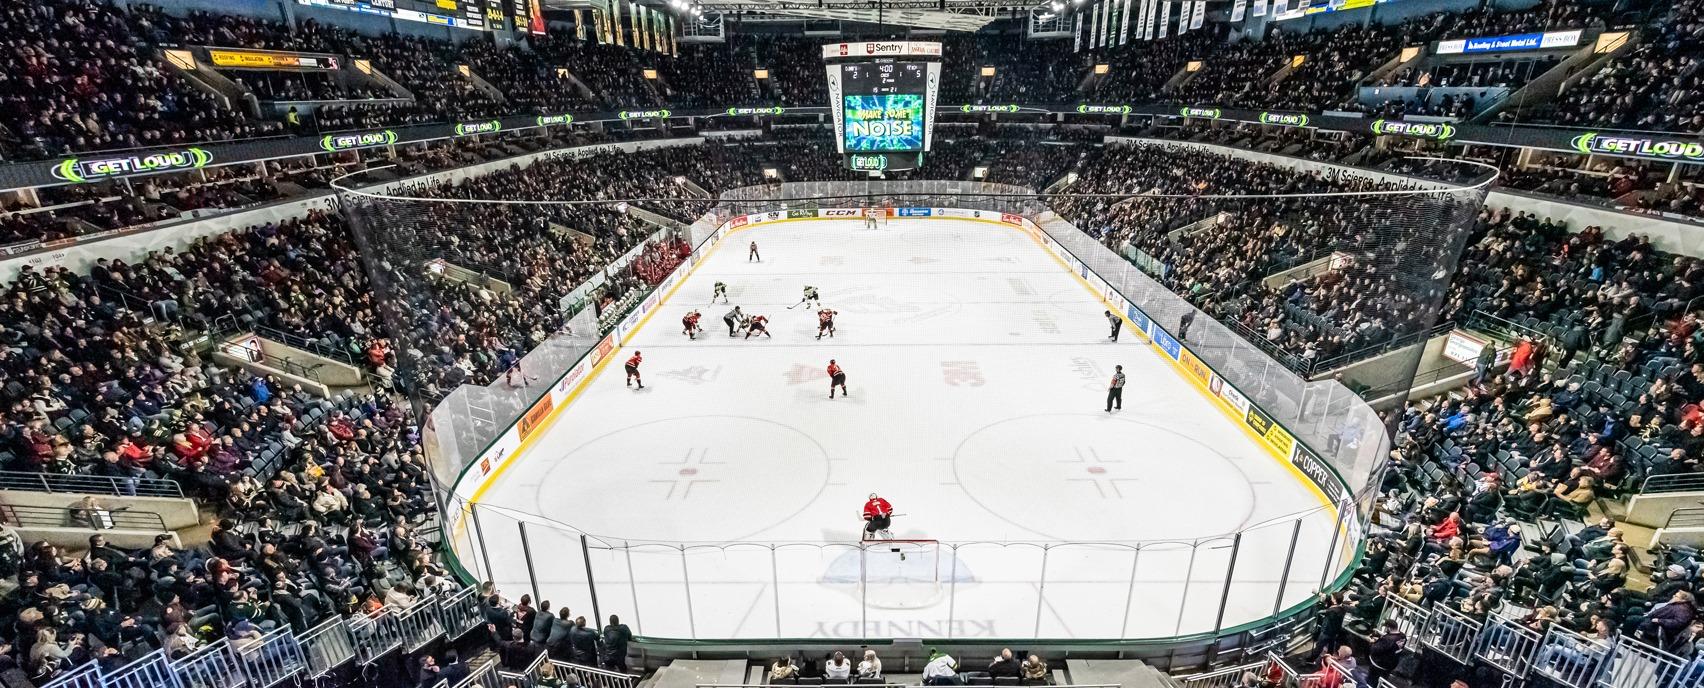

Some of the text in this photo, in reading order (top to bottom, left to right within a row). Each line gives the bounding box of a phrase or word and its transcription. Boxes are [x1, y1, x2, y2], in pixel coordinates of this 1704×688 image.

[1543, 36, 1562, 45] PRESS
[875, 43, 903, 53] Sentry
[879, 65, 893, 73] 4:00
[543, 115, 565, 124] GET LOUD
[835, 93, 843, 137] NAVIGATOR
[928, 90, 936, 135] NAVIGATOR
[1189, 108, 1214, 117] GET LOUD
[1267, 114, 1299, 124] GET LOUD
[464, 122, 493, 133] GET LOUD
[853, 120, 914, 137] NOISE
[1386, 123, 1438, 137] GET LOUD
[338, 133, 386, 148] GET LOUD
[1602, 138, 1704, 158] GET LOUD
[91, 152, 186, 175] GET LOUD
[856, 156, 879, 167] GET LOUD
[1326, 167, 1340, 179] 3M
[385, 182, 417, 198] Applied
[417, 180, 426, 189] to
[427, 175, 441, 189] Life
[1294, 447, 1328, 488] X COPPER
[809, 619, 998, 638] KENNEDY
